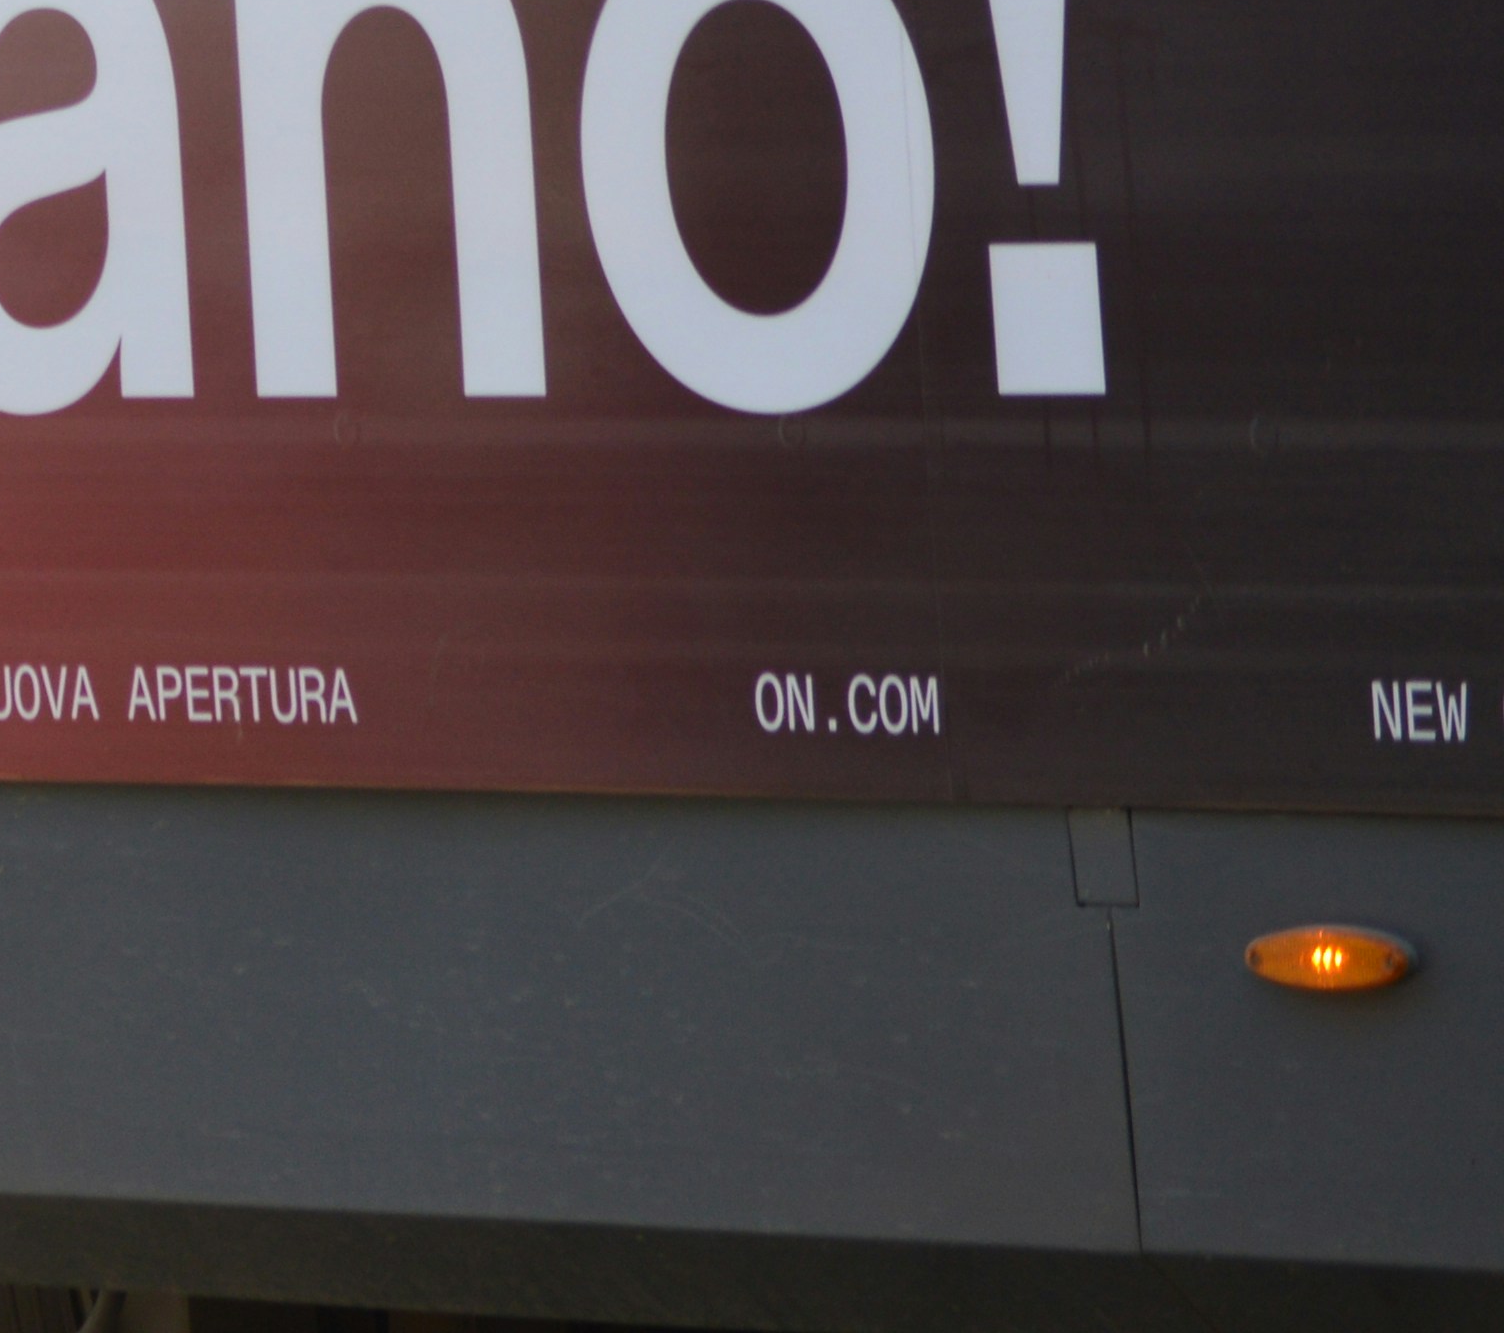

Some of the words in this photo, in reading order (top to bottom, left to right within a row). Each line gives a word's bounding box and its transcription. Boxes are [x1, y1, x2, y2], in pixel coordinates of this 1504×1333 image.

[128, 666, 358, 725] APERTURA
[754, 672, 941, 736] ON.COM
[1371, 680, 1468, 742] NEW
